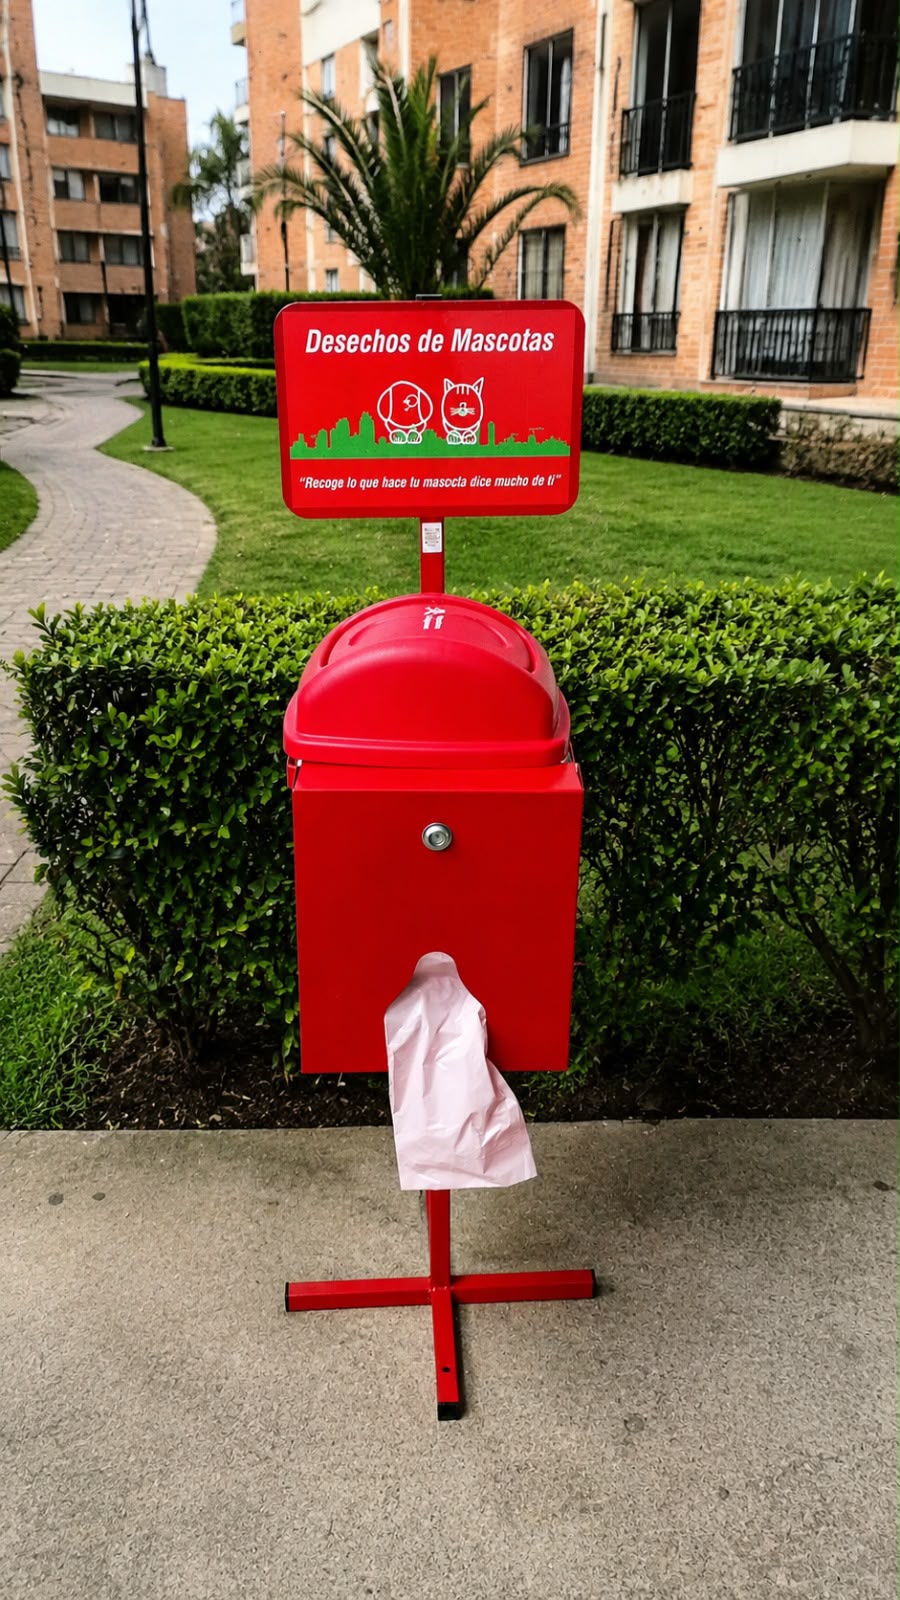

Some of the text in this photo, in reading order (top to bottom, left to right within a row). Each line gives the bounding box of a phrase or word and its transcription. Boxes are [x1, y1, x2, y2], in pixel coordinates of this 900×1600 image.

[305, 327, 555, 354] Desechos de Mascotas
[346, 476, 357, 489] lo
[359, 478, 380, 491] que
[381, 476, 407, 488] hace
[409, 476, 420, 488] tu
[469, 475, 492, 488] dice
[493, 475, 528, 487] mucho
[531, 475, 545, 487] de
